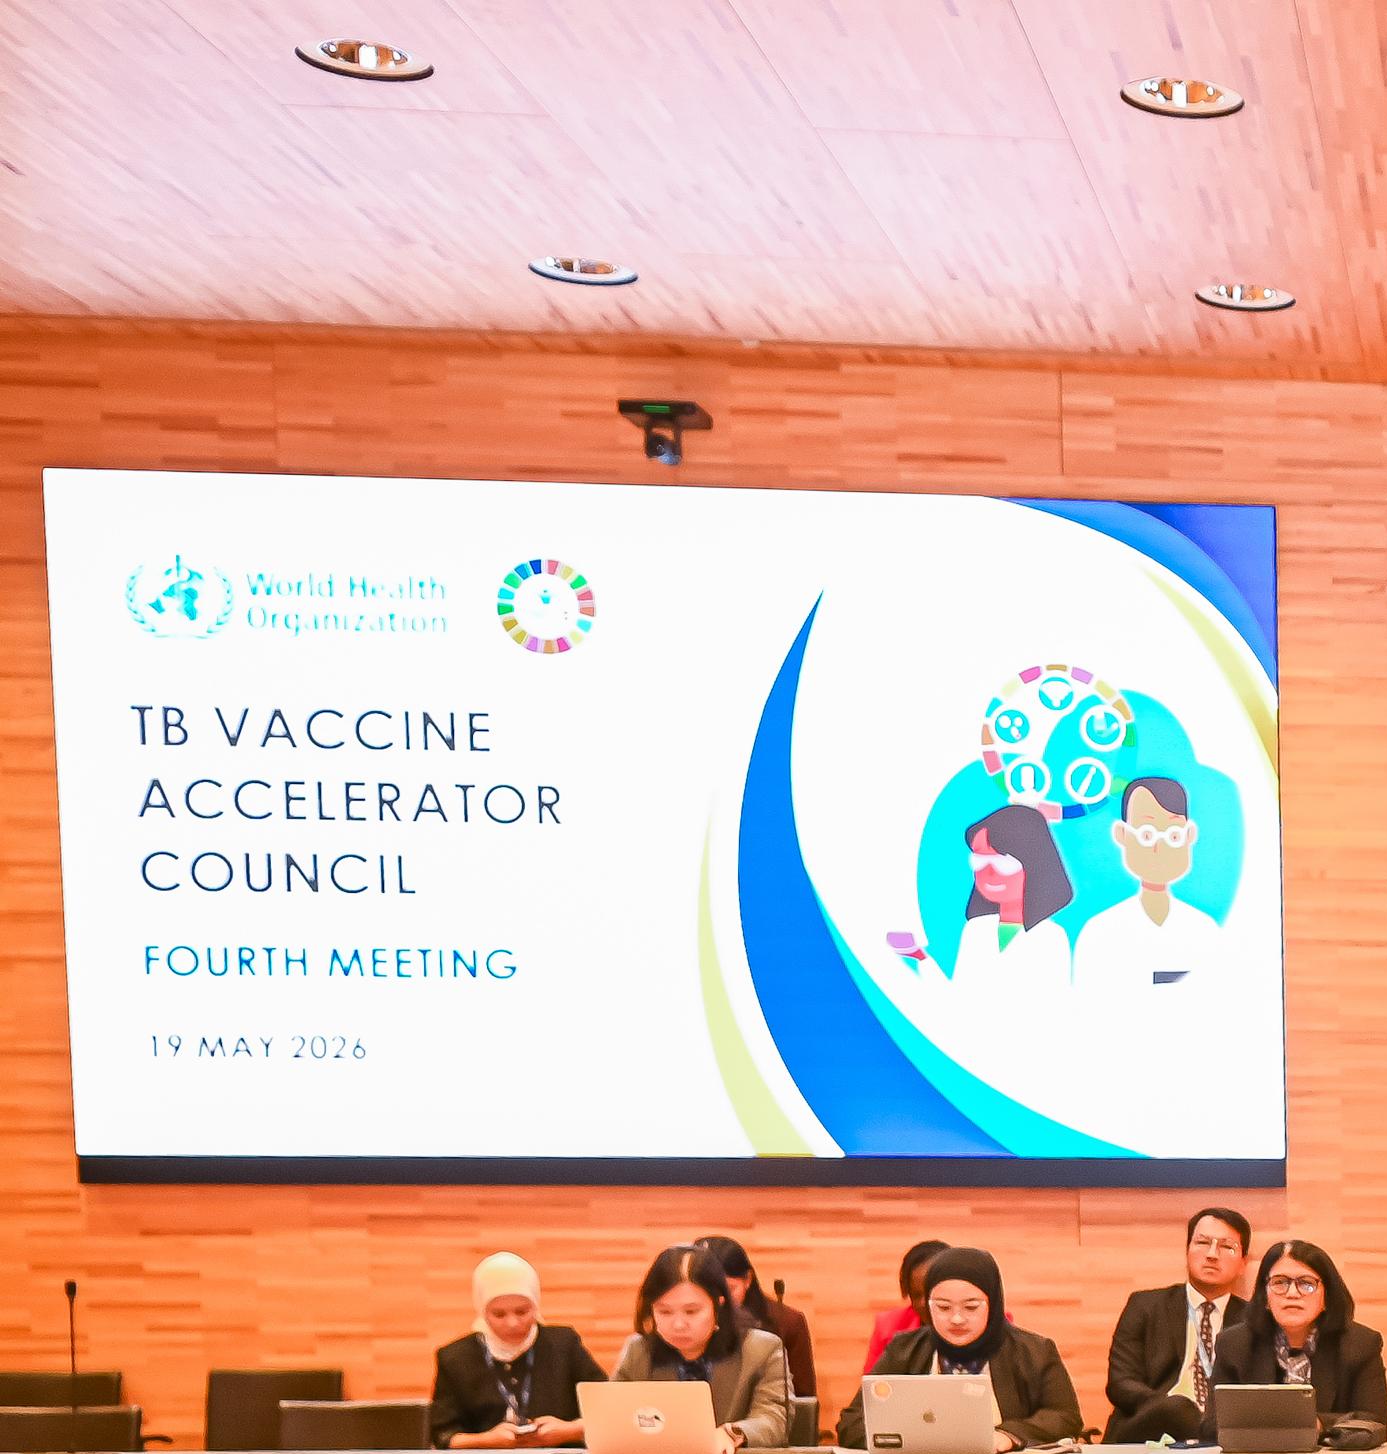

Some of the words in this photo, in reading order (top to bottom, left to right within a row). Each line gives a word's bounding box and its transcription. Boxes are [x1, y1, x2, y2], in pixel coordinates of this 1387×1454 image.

[246, 571, 335, 600] World
[348, 574, 447, 602] Health
[246, 606, 449, 639] Organization
[130, 704, 189, 747] TB
[213, 706, 491, 753] VACCINE
[137, 777, 562, 825] ACCELERATOR
[139, 850, 417, 895] COUNCIL
[143, 944, 309, 978] FOURTH
[328, 946, 518, 981] MEETING
[151, 1034, 183, 1058] 19
[198, 1035, 274, 1059] MAY
[291, 1035, 367, 1060] 2026
